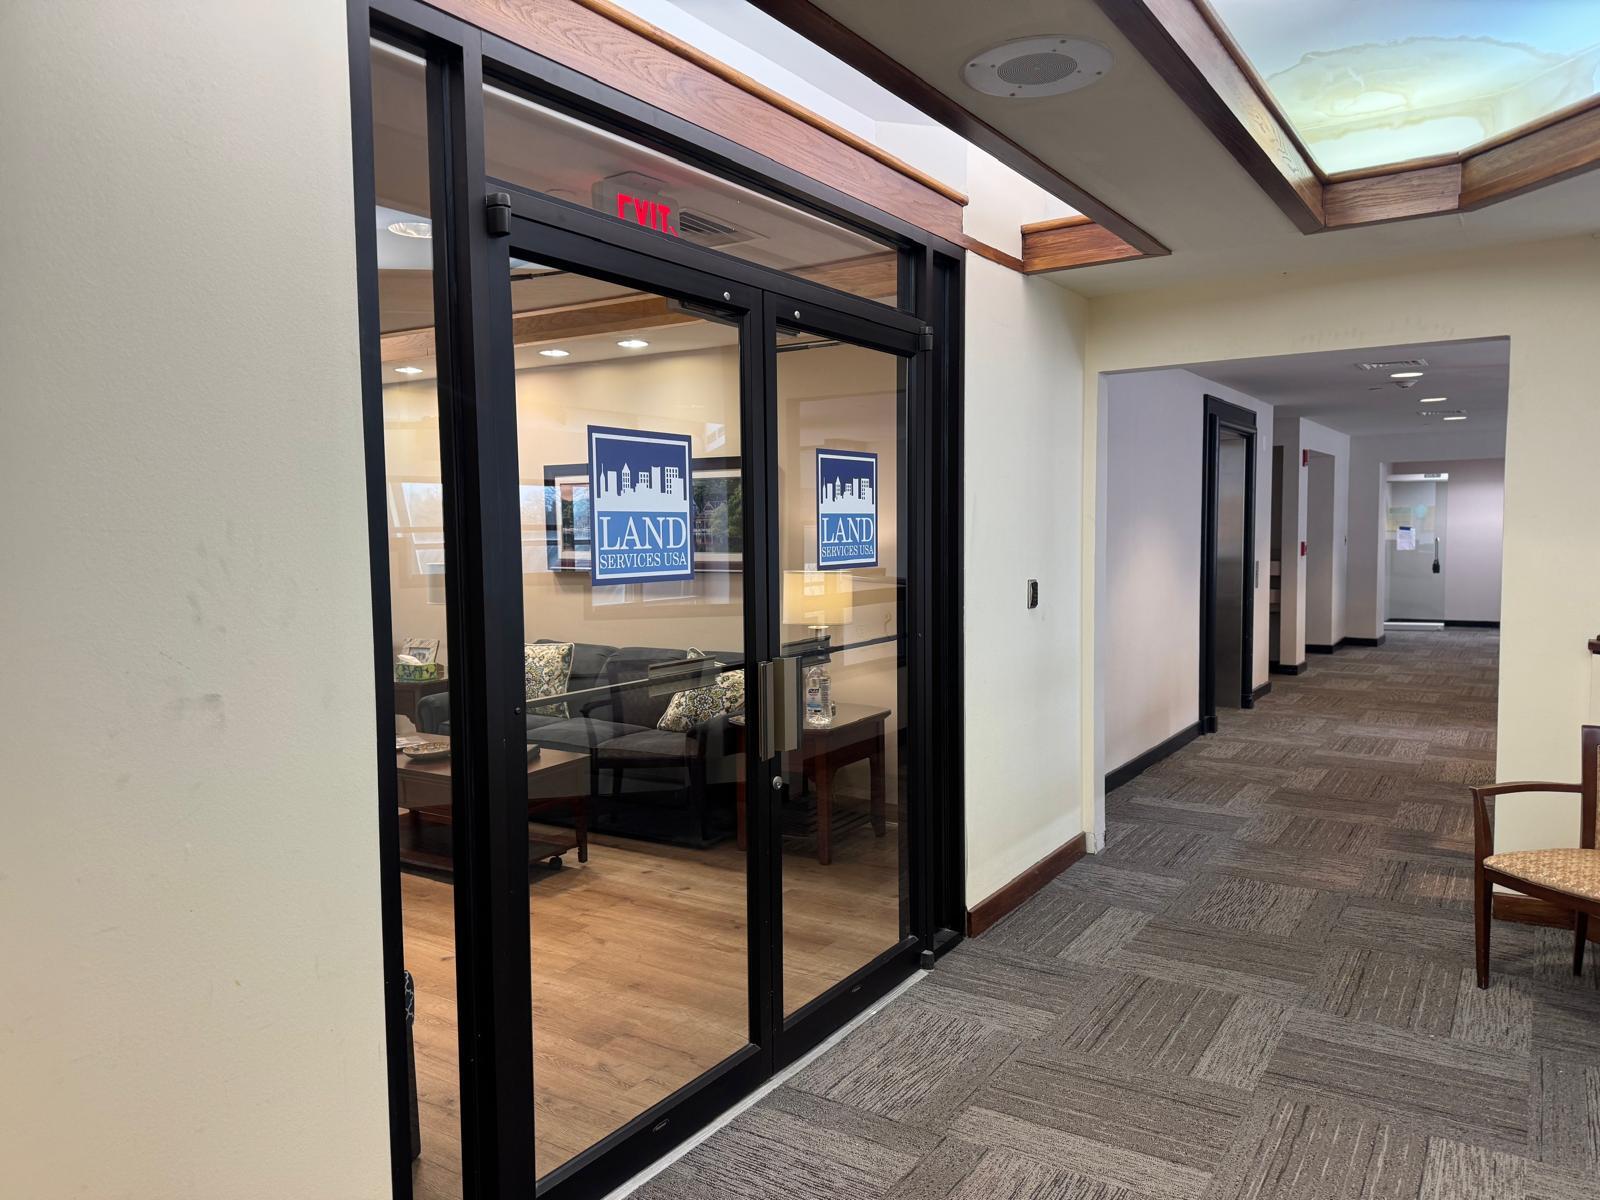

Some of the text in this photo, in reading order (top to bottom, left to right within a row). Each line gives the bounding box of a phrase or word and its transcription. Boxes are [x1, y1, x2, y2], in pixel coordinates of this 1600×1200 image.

[600, 516, 687, 550] LAND
[822, 517, 874, 543] LAND
[600, 552, 687, 569] SERVICES USA
[821, 544, 874, 557] SERVICES USA
